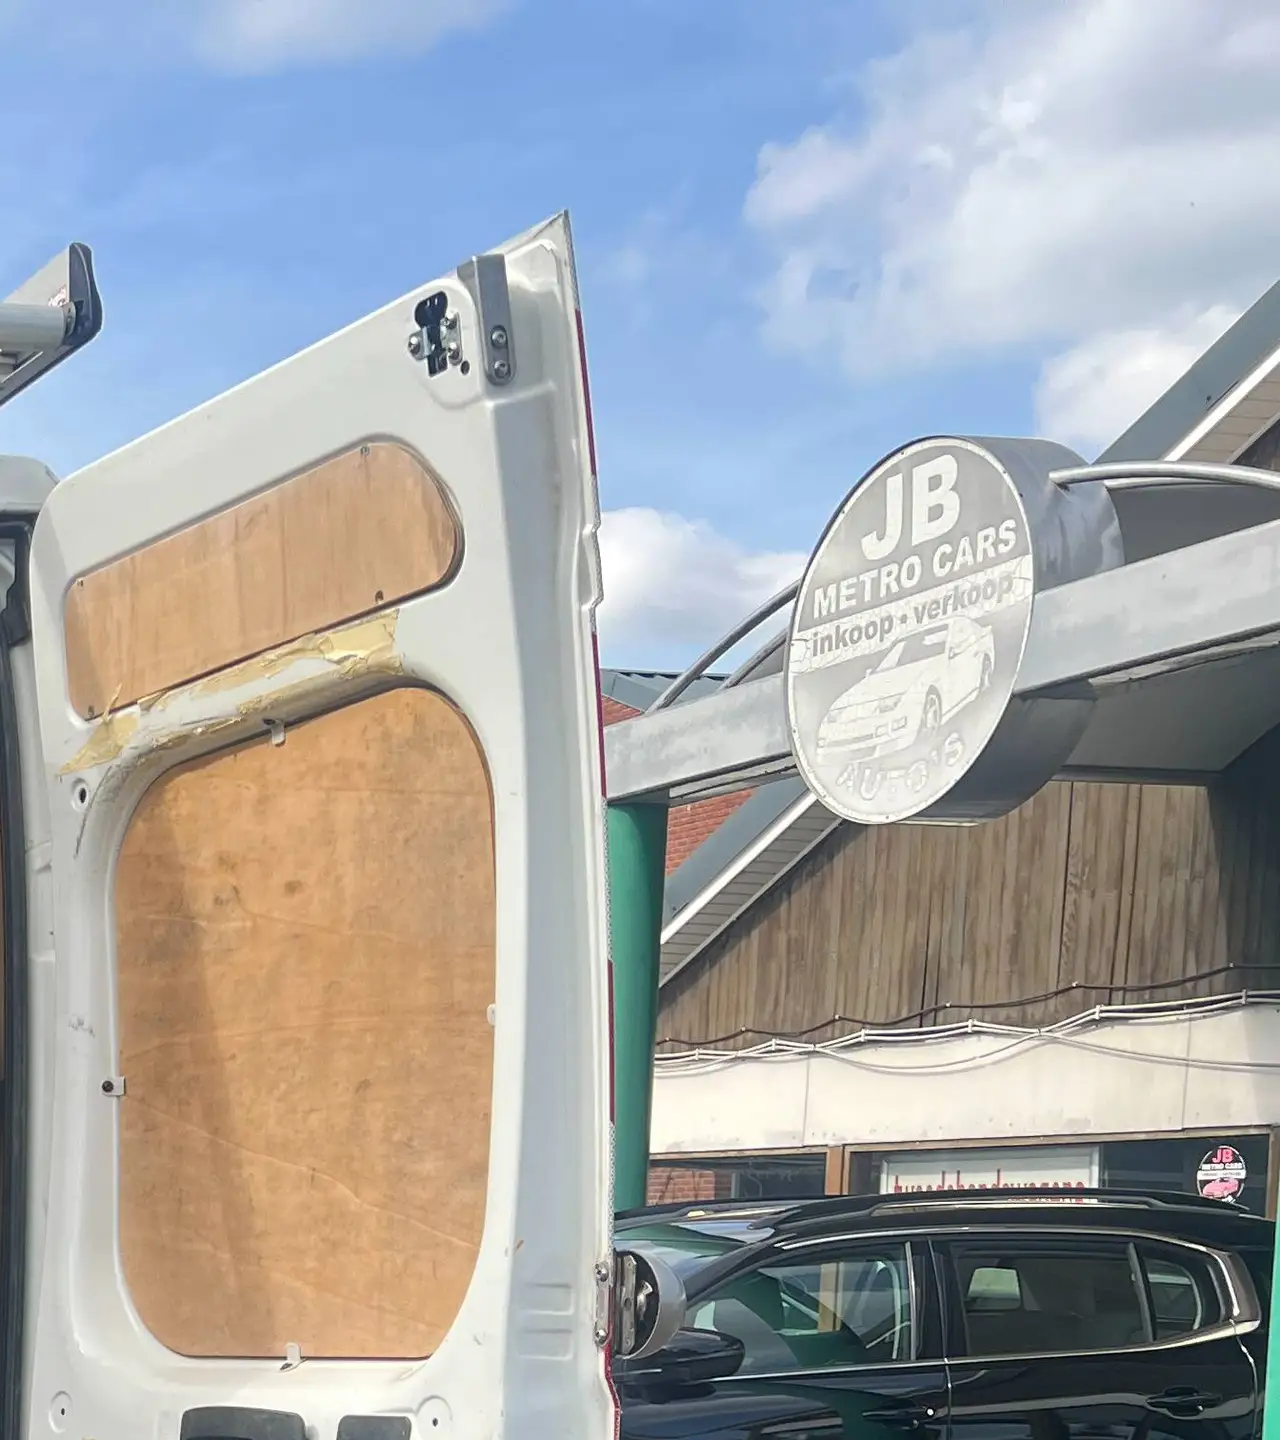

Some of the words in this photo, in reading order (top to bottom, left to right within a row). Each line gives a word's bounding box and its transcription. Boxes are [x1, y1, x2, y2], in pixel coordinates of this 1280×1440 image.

[860, 454, 961, 561] JB
[813, 553, 922, 620] METRO
[932, 519, 1017, 579] CARS
[812, 613, 894, 657] inkoop
[913, 571, 1014, 626] verkoop
[835, 732, 966, 801] AUTO'S
[1212, 1149, 1233, 1163] JB
